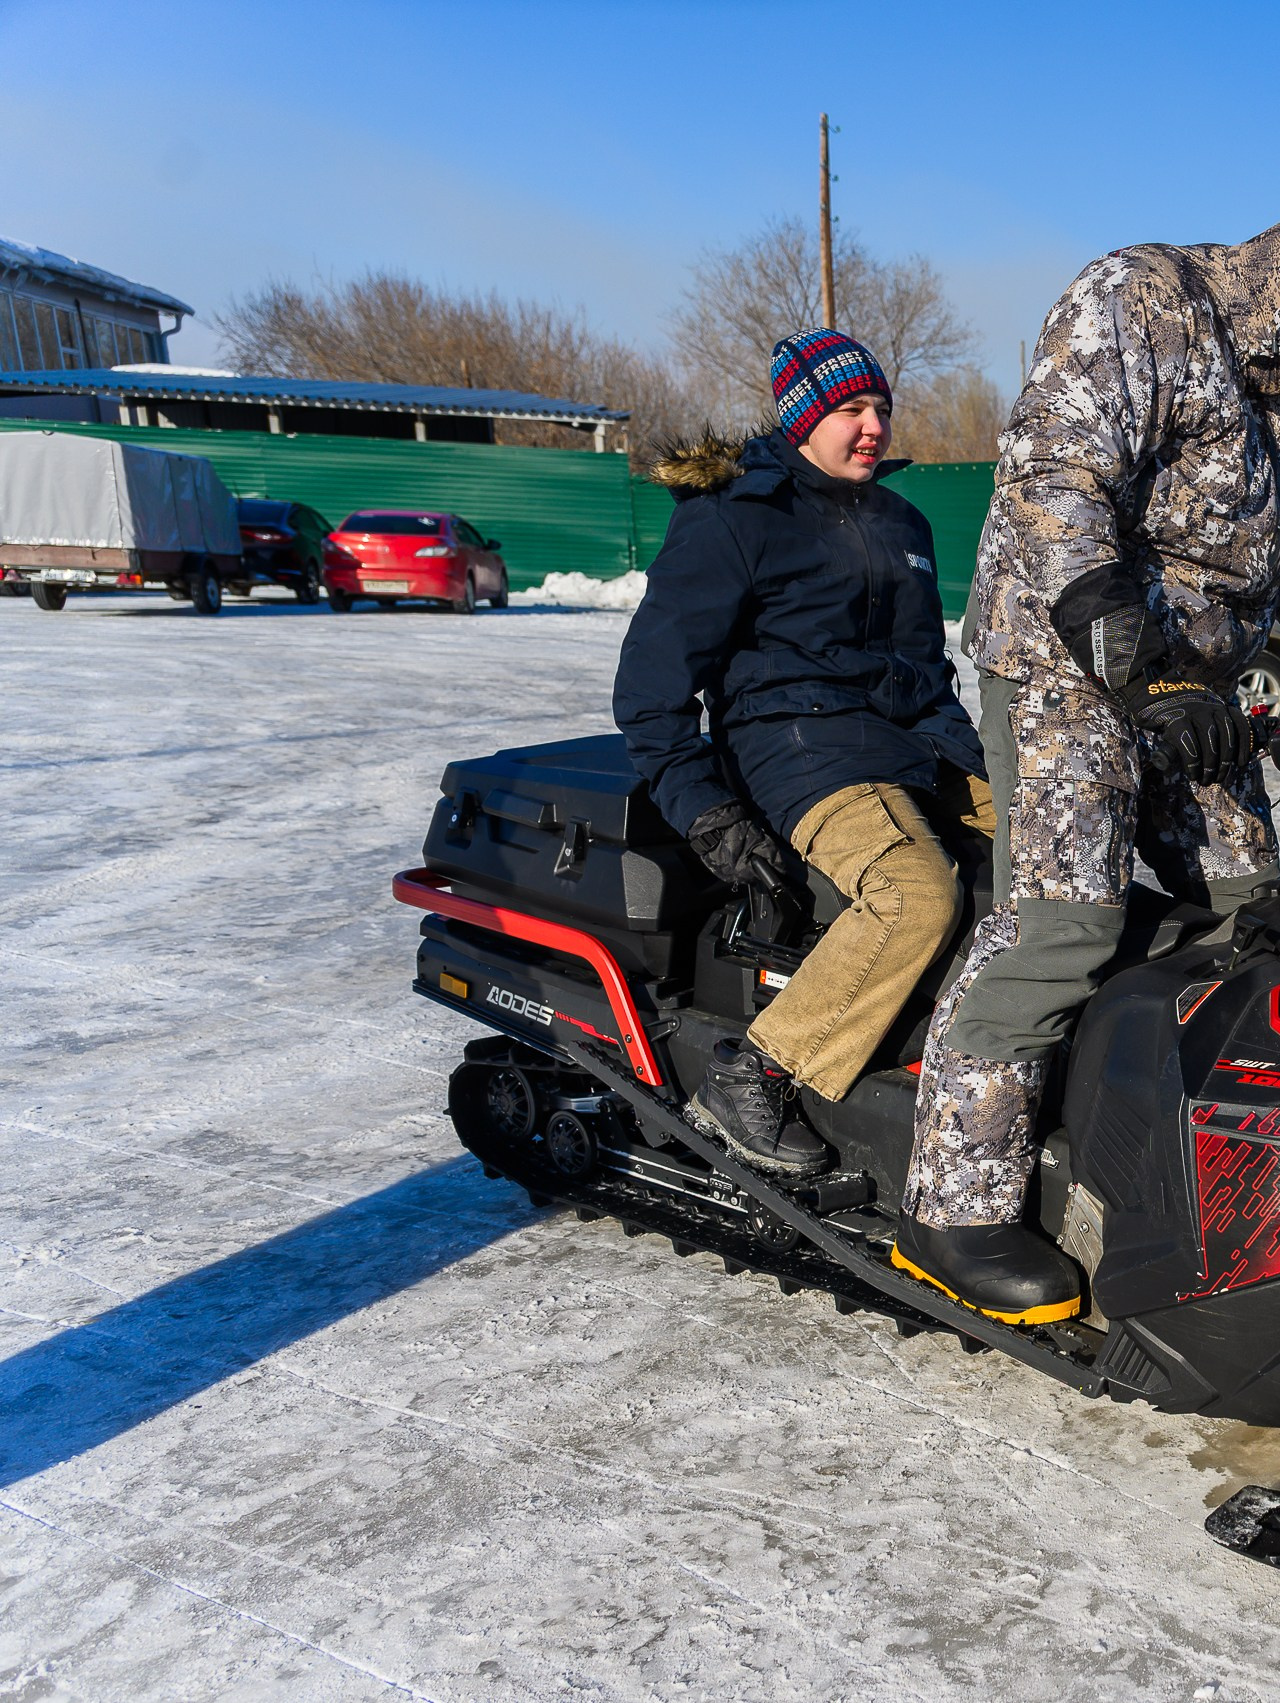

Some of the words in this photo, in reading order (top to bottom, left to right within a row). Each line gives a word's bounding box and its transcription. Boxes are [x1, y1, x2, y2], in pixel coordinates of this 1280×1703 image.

[813, 351, 860, 376] STREET
[816, 356, 863, 381] STREET
[820, 362, 866, 387] STREET
[822, 368, 869, 392] STREET
[825, 374, 871, 398] STREET
[828, 381, 872, 404] STREET
[779, 382, 812, 417] STREET
[781, 388, 815, 422] STREET
[785, 393, 818, 428] STREET
[790, 399, 821, 432] STREET
[796, 404, 825, 438] STREET
[486, 985, 555, 1026] AODES
[1230, 1059, 1276, 1070] SWT
